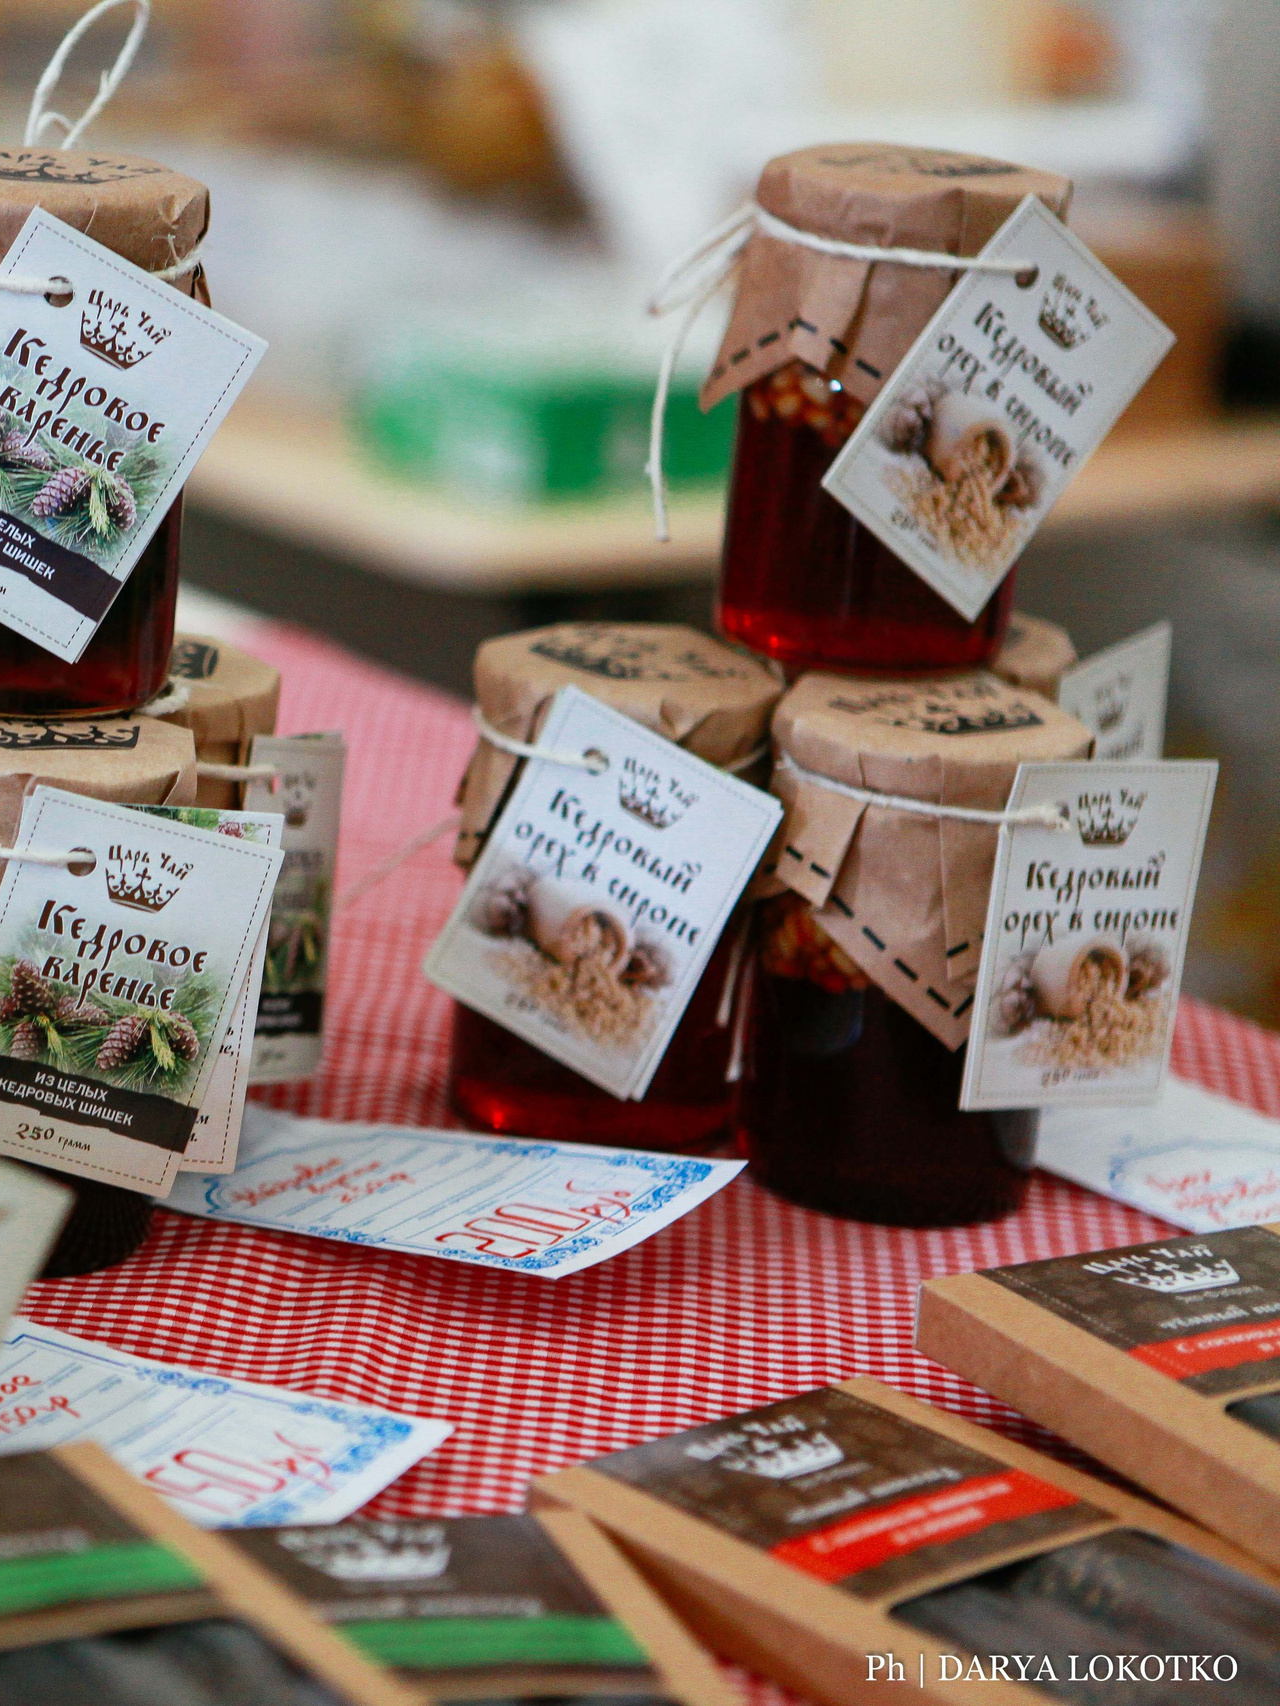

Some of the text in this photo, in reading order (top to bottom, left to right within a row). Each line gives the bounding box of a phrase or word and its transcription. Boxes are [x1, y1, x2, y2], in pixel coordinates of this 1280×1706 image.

[3, 327, 166, 444] Кедровое
[2, 537, 56, 582] ШИШЕК
[107, 843, 195, 883] Царь Чай
[36, 899, 209, 976] Кедровое
[40, 954, 177, 1012] варенье
[33, 1071, 109, 1103] ИЗ ЦЕЛЫХ
[77, 1098, 134, 1128] ШИШЕК
[14, 1121, 92, 1154] 250 грамм
[434, 1202, 592, 1260] 200
